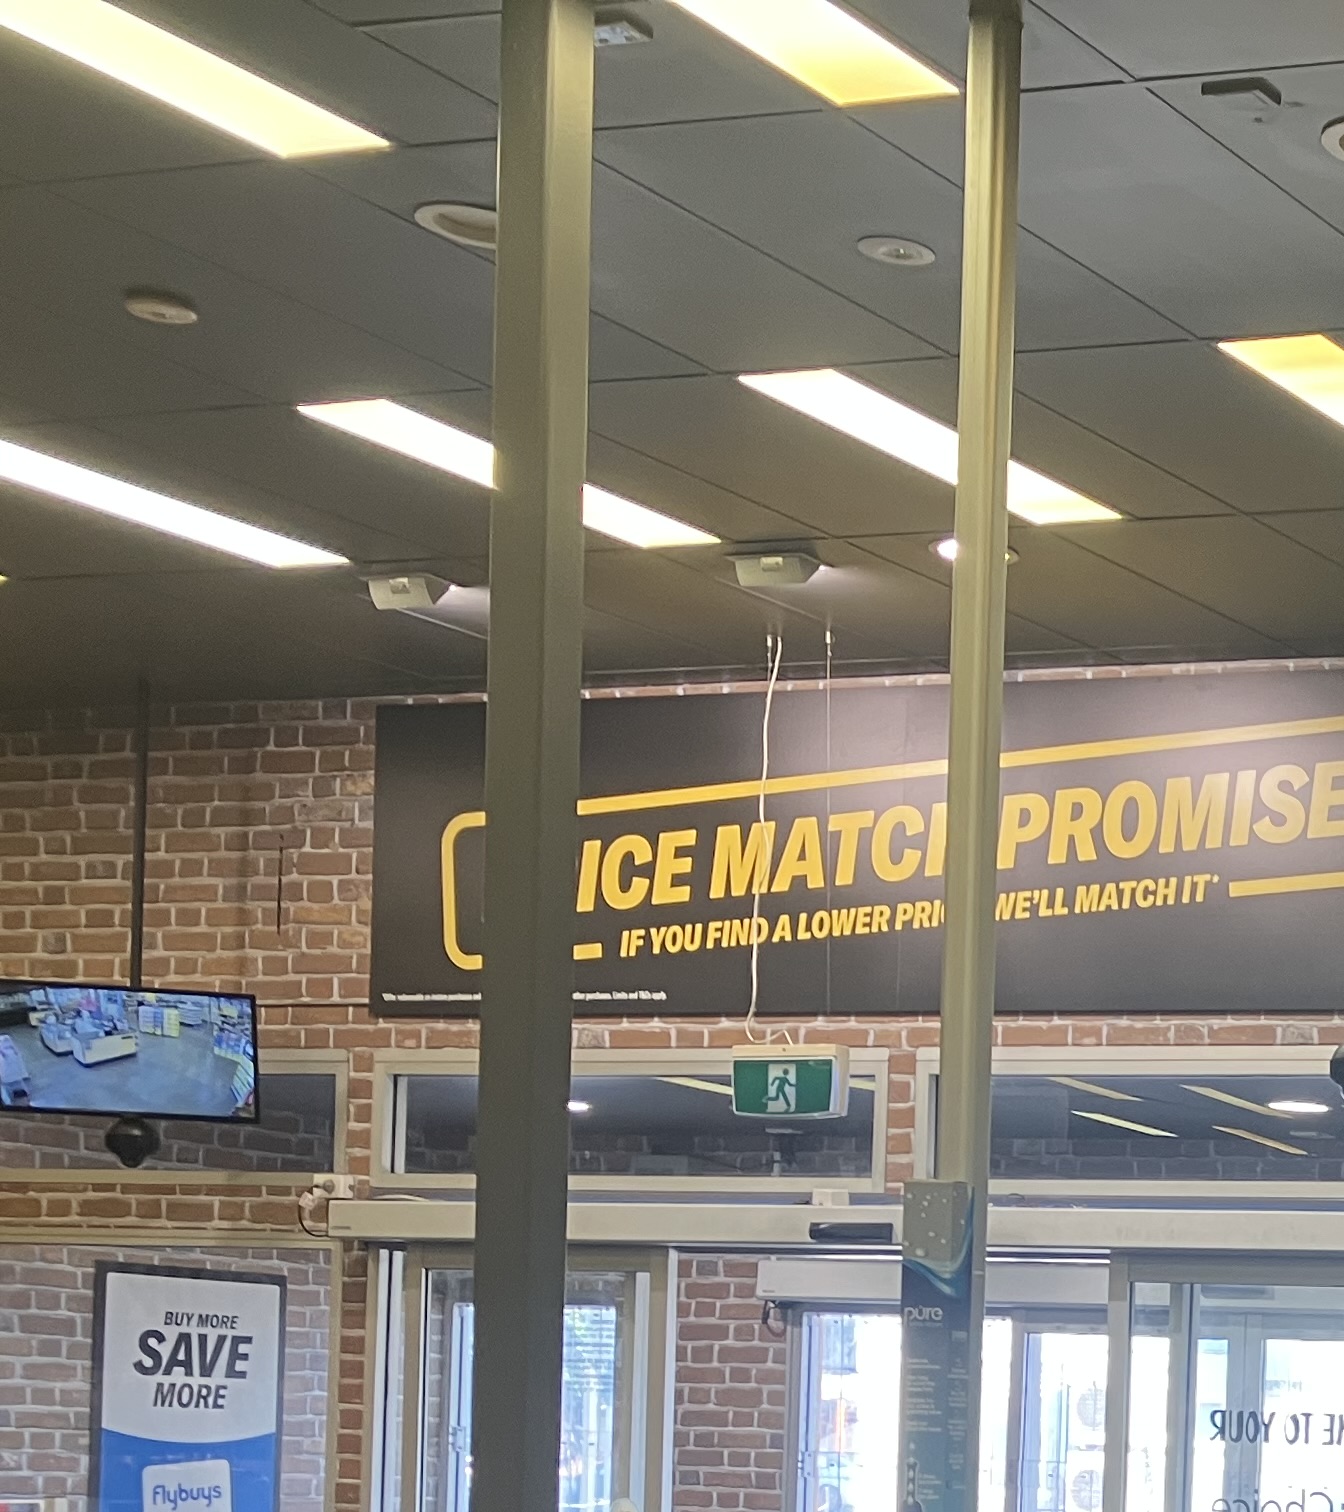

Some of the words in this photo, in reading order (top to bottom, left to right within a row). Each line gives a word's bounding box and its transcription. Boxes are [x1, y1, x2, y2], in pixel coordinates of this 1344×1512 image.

[576, 828, 698, 913] ICE
[620, 929, 645, 957] IF
[650, 923, 702, 953] YOU
[706, 917, 769, 949] FIND
[772, 919, 792, 942] A
[797, 904, 889, 940] LOWER
[895, 899, 944, 930] PRI
[1075, 877, 1177, 914] MATCH
[164, 1311, 194, 1327] BUY
[197, 1314, 239, 1329] MORE
[133, 1329, 253, 1379] SAVE
[152, 1383, 228, 1409] MORE
